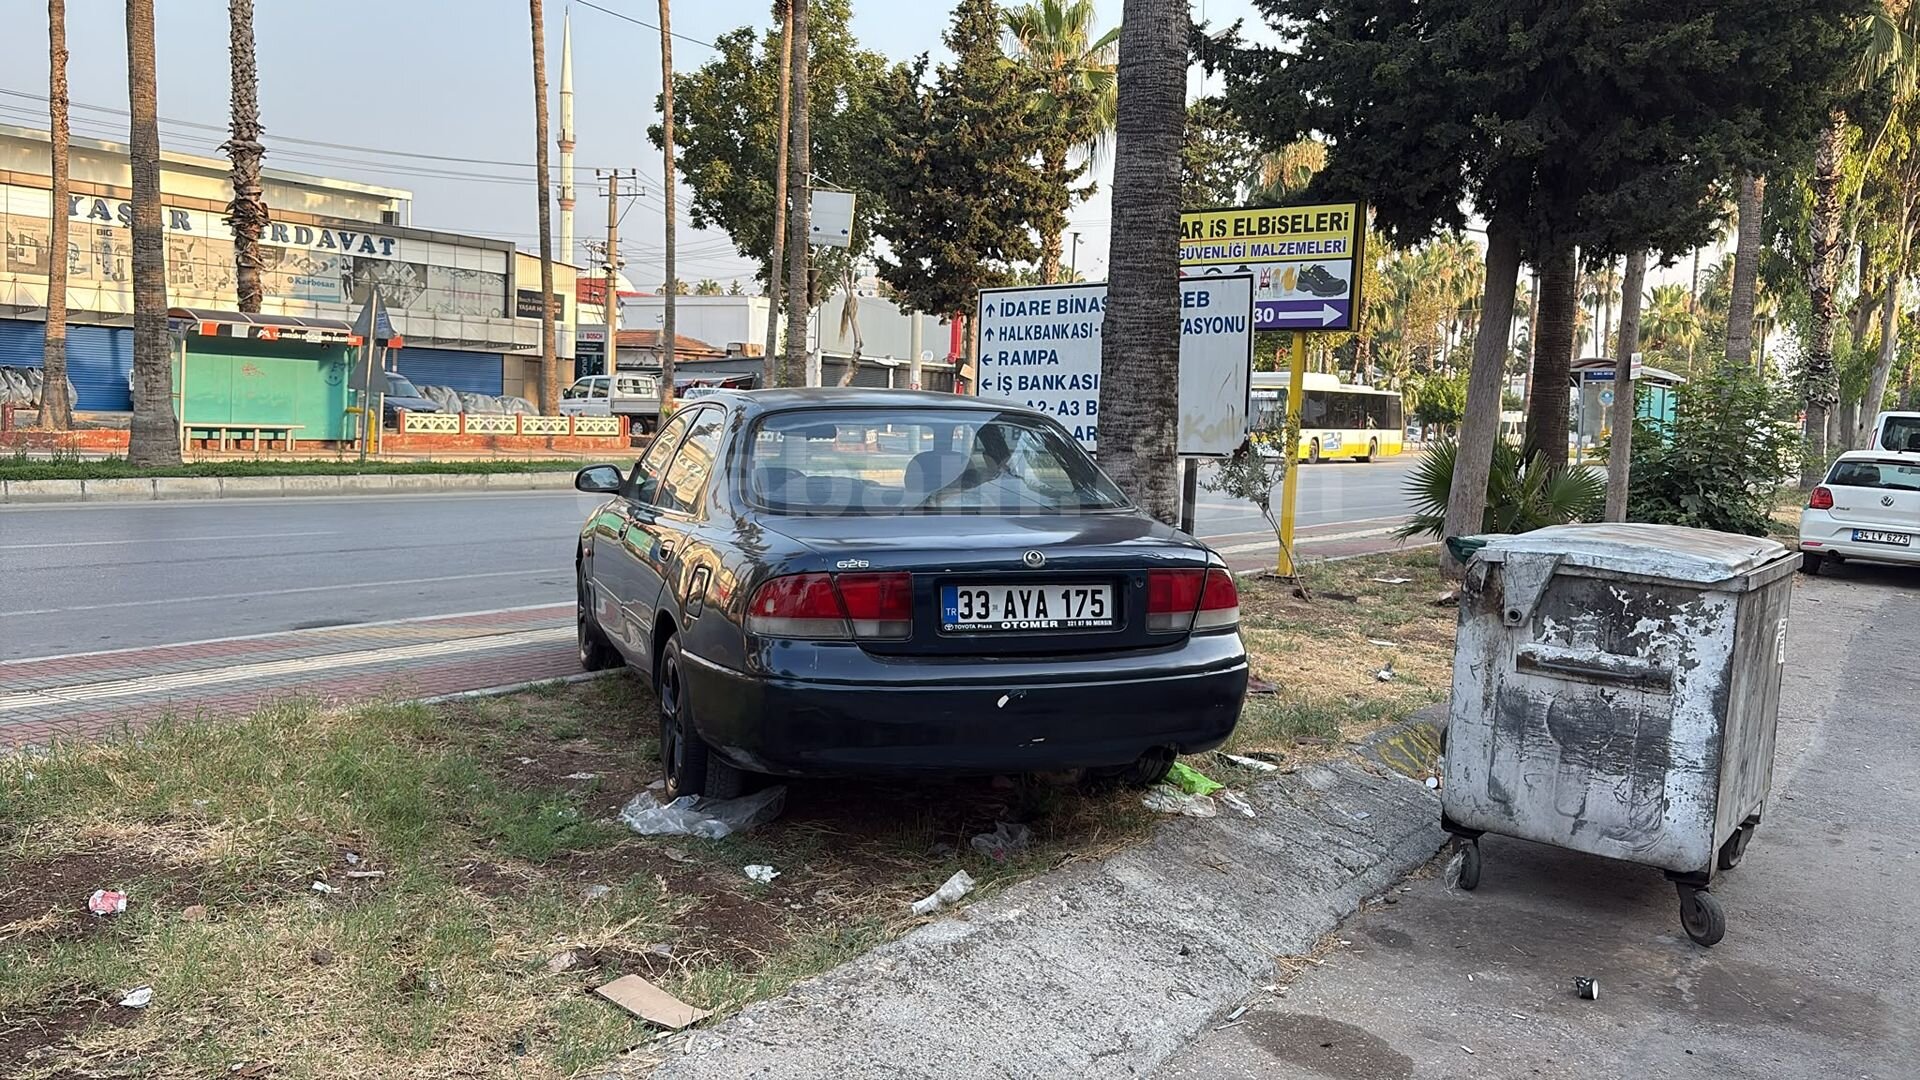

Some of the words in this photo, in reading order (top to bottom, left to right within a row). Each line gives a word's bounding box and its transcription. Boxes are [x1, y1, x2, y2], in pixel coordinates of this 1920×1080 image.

[68, 195, 192, 231] YAŞR
[231, 222, 396, 256] RDAVAT
[1251, 237, 1347, 257] MALZEMELERİ
[294, 276, 336, 289] Karbosan
[1000, 298, 1051, 317] İDARE
[1179, 291, 1210, 308] EB
[998, 350, 1059, 366] RAMPA
[997, 372, 1012, 395] İŞ
[1018, 374, 1098, 390] BANKASI
[1858, 531, 1869, 540] 34
[1886, 534, 1908, 544] 6275
[836, 560, 869, 569] 626
[946, 607, 957, 616] TR
[959, 591, 990, 619] 33
[1004, 590, 1048, 619] AYA
[1061, 589, 1103, 618] 175
[1001, 620, 1058, 629] OTOMER
